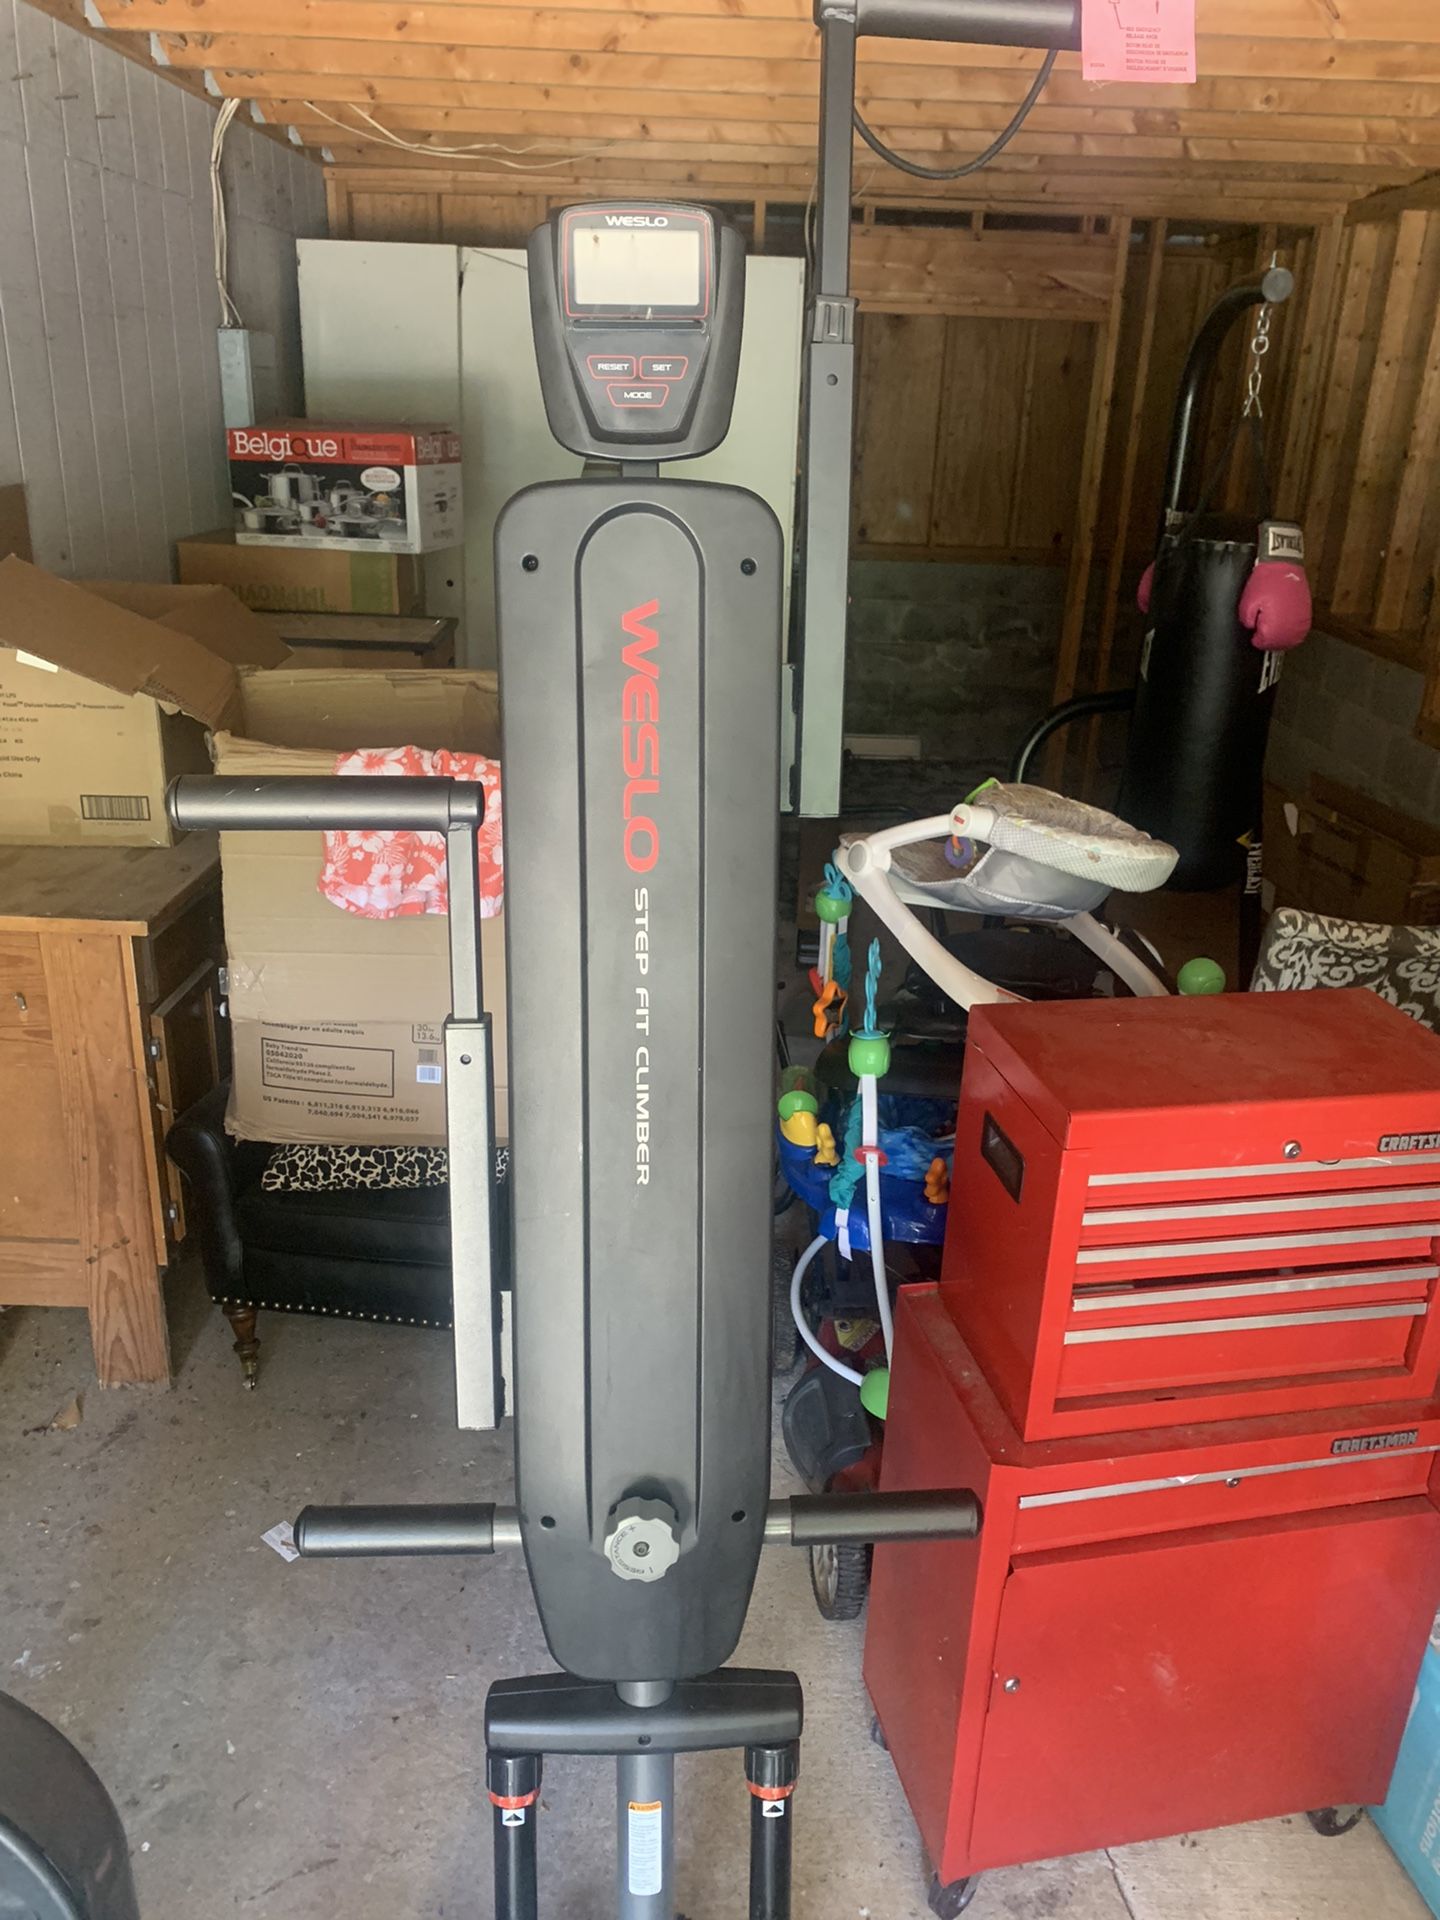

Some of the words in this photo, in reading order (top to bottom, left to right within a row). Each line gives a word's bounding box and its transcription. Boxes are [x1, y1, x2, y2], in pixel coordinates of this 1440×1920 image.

[605, 215, 669, 227] WESLO
[597, 363, 630, 371] RESET
[652, 363, 672, 371] SET
[623, 391, 652, 399] MODE
[621, 598, 660, 873] WESLO
[25, 755, 41, 764] Only
[634, 887, 649, 976] STEP
[635, 987, 649, 1036] FIT
[265, 1042, 279, 1050] Baby
[281, 1044, 298, 1052] Trend
[265, 1057, 295, 1066] California
[273, 1097, 300, 1106] Patents
[636, 1046, 650, 1185] CLIMBER
[1332, 1430, 1418, 1454] CRAFTSMAN
